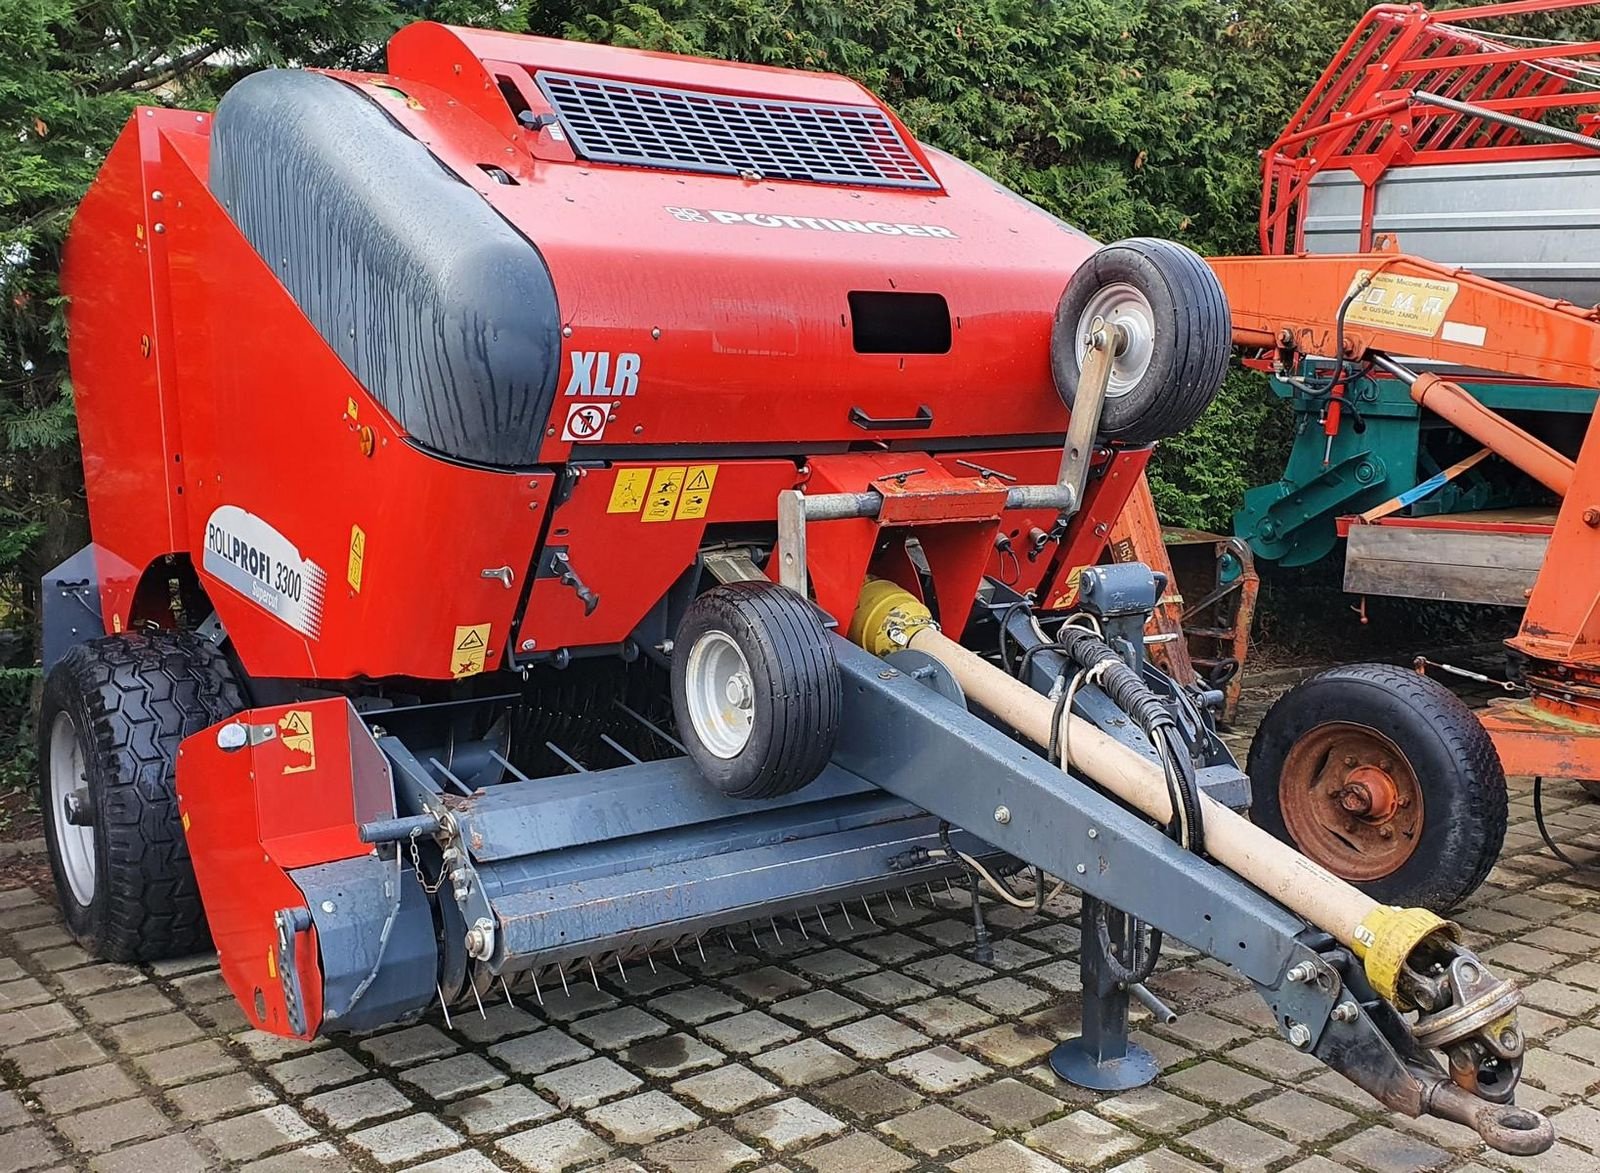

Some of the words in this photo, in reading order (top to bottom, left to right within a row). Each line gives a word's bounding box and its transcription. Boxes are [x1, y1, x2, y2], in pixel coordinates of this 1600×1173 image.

[708, 209, 960, 239] PÖTTINGER
[564, 351, 641, 396] XLR
[209, 522, 271, 585] ROLLPROFI
[275, 561, 302, 603] 3300
